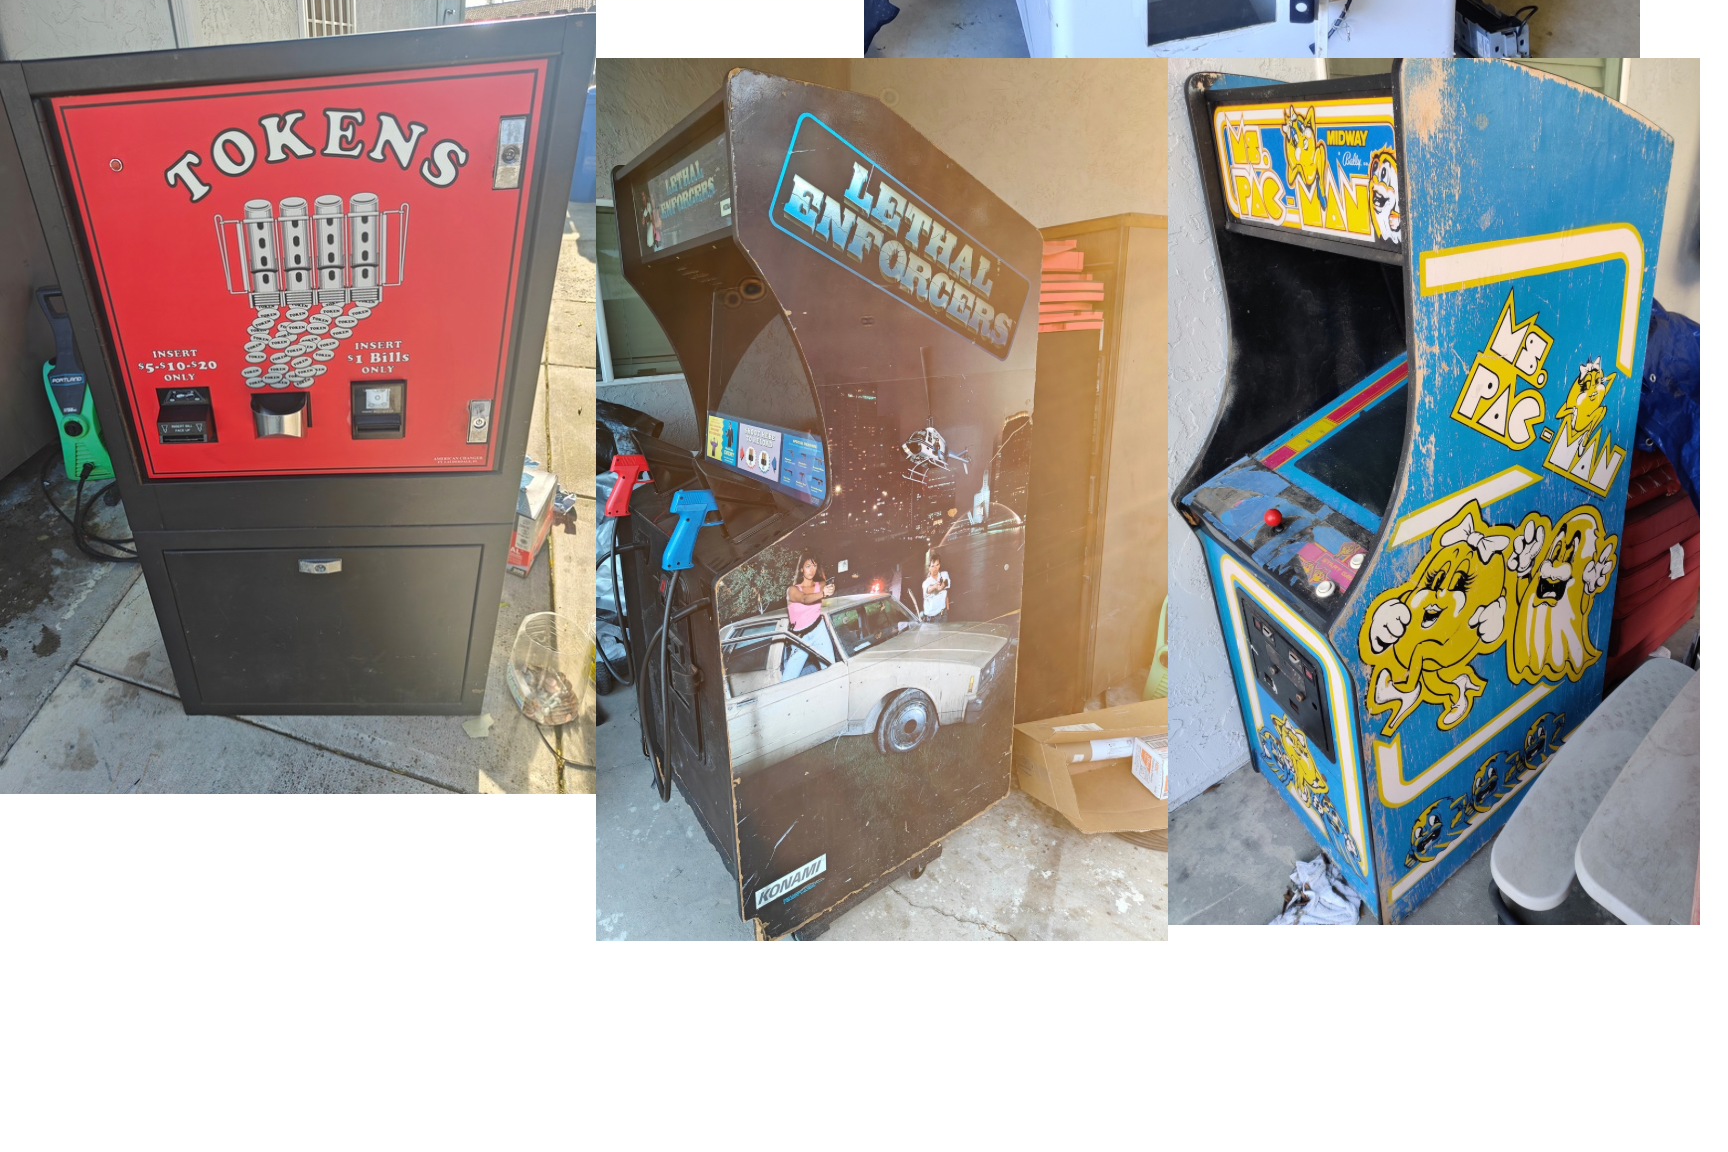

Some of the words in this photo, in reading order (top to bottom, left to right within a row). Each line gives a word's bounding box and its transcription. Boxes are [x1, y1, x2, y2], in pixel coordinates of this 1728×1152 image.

[1326, 130, 1368, 146] MIDWAY
[165, 107, 469, 203] TOKENS
[1342, 152, 1362, 168] Bally
[664, 160, 704, 196] LETHAL
[660, 176, 716, 220] ENFORCERS
[1230, 159, 1375, 242] PAC-MAN
[844, 161, 993, 298] LETHAL
[784, 174, 1013, 349] ENFORCERS
[355, 341, 402, 350] INSERT
[153, 350, 197, 358] INSERT
[348, 355, 363, 364] $1
[370, 352, 409, 363] Bills
[138, 361, 217, 373] $5-$10-$20
[362, 366, 394, 374] ONLY
[164, 373, 195, 381] ONLY
[1451, 354, 1626, 497] PAC-MAN
[753, 437, 773, 448] RELOAD
[762, 431, 776, 441] HERE
[1322, 558, 1342, 572] START
[758, 860, 821, 905] KONAMI
